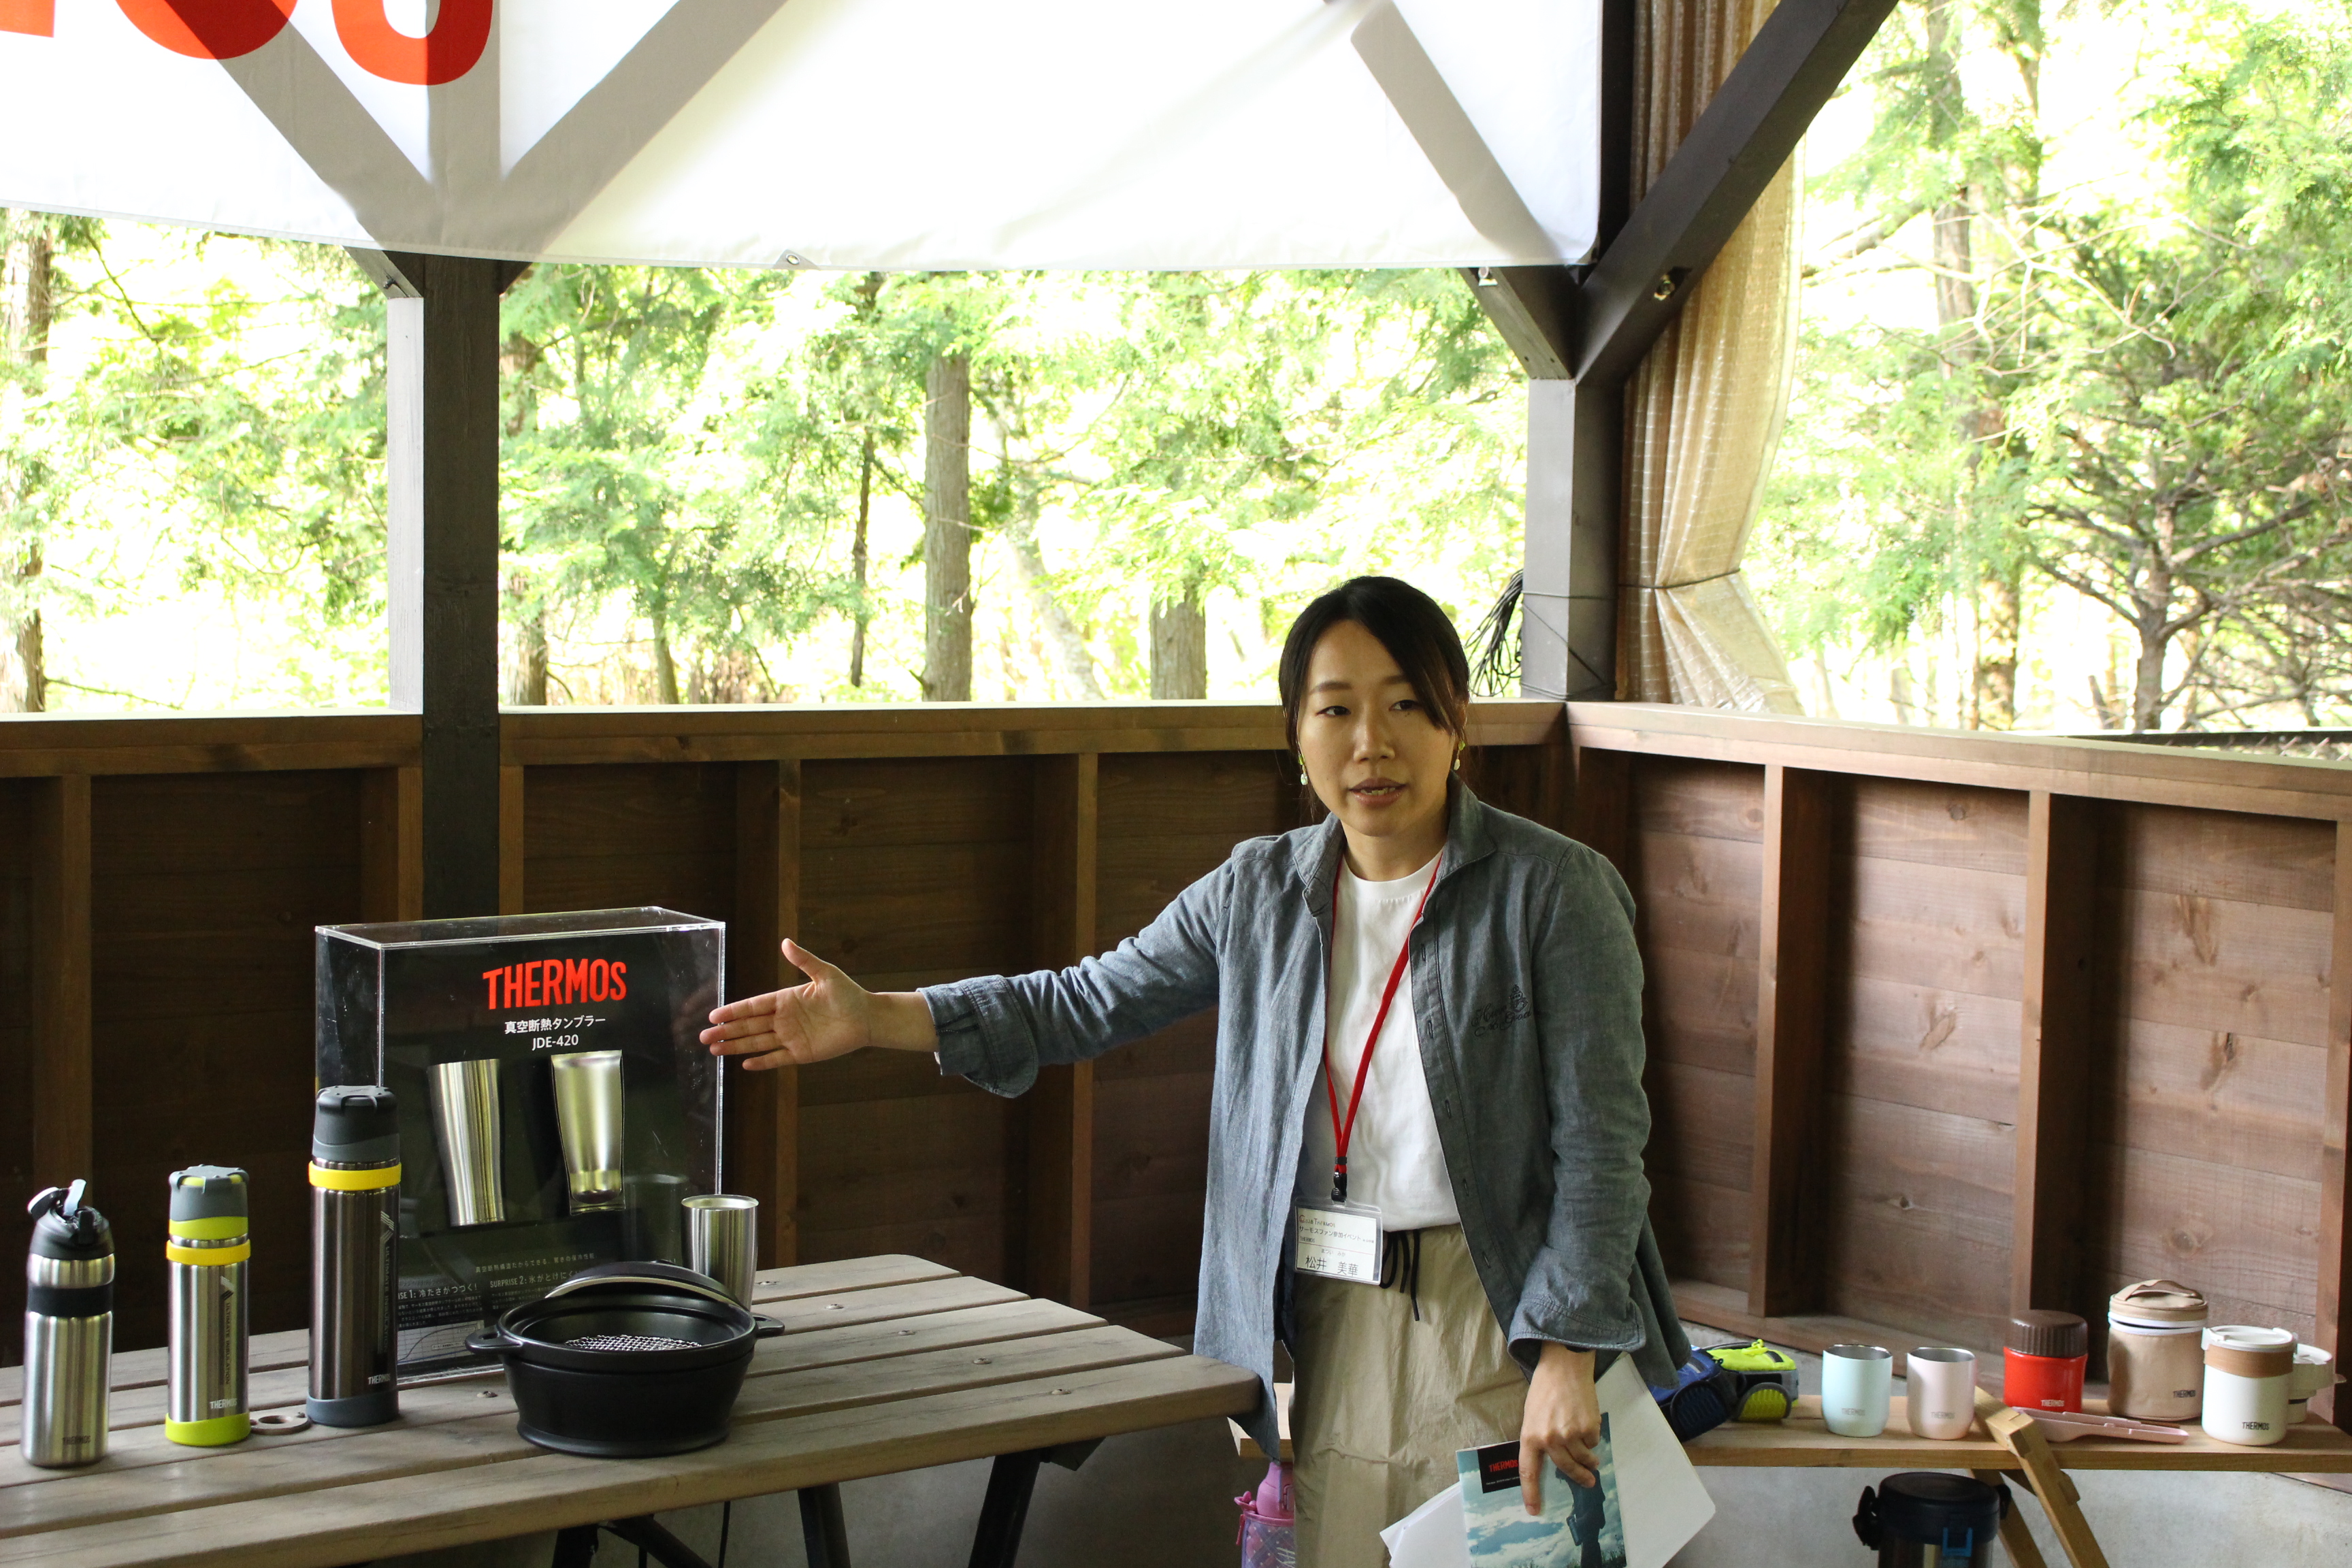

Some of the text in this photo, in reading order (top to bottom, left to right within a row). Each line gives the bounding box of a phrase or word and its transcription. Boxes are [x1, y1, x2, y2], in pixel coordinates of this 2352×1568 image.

[483, 958, 627, 1010] THERMOS
[505, 1015, 606, 1034] 真空断熱タンブラー
[532, 1034, 578, 1051] JDE-420
[1299, 1226, 1361, 1241] サーモスファン参加イベント
[1305, 1255, 1358, 1277] 松井 美華
[490, 1277, 519, 1288] SURPRISE
[368, 1373, 391, 1384] THERMOS
[2173, 1390, 2196, 1399] THERMOS
[210, 1398, 238, 1409] THERMOS
[2242, 1421, 2270, 1431] THERMOS
[1489, 1459, 1518, 1472] THERMOS
